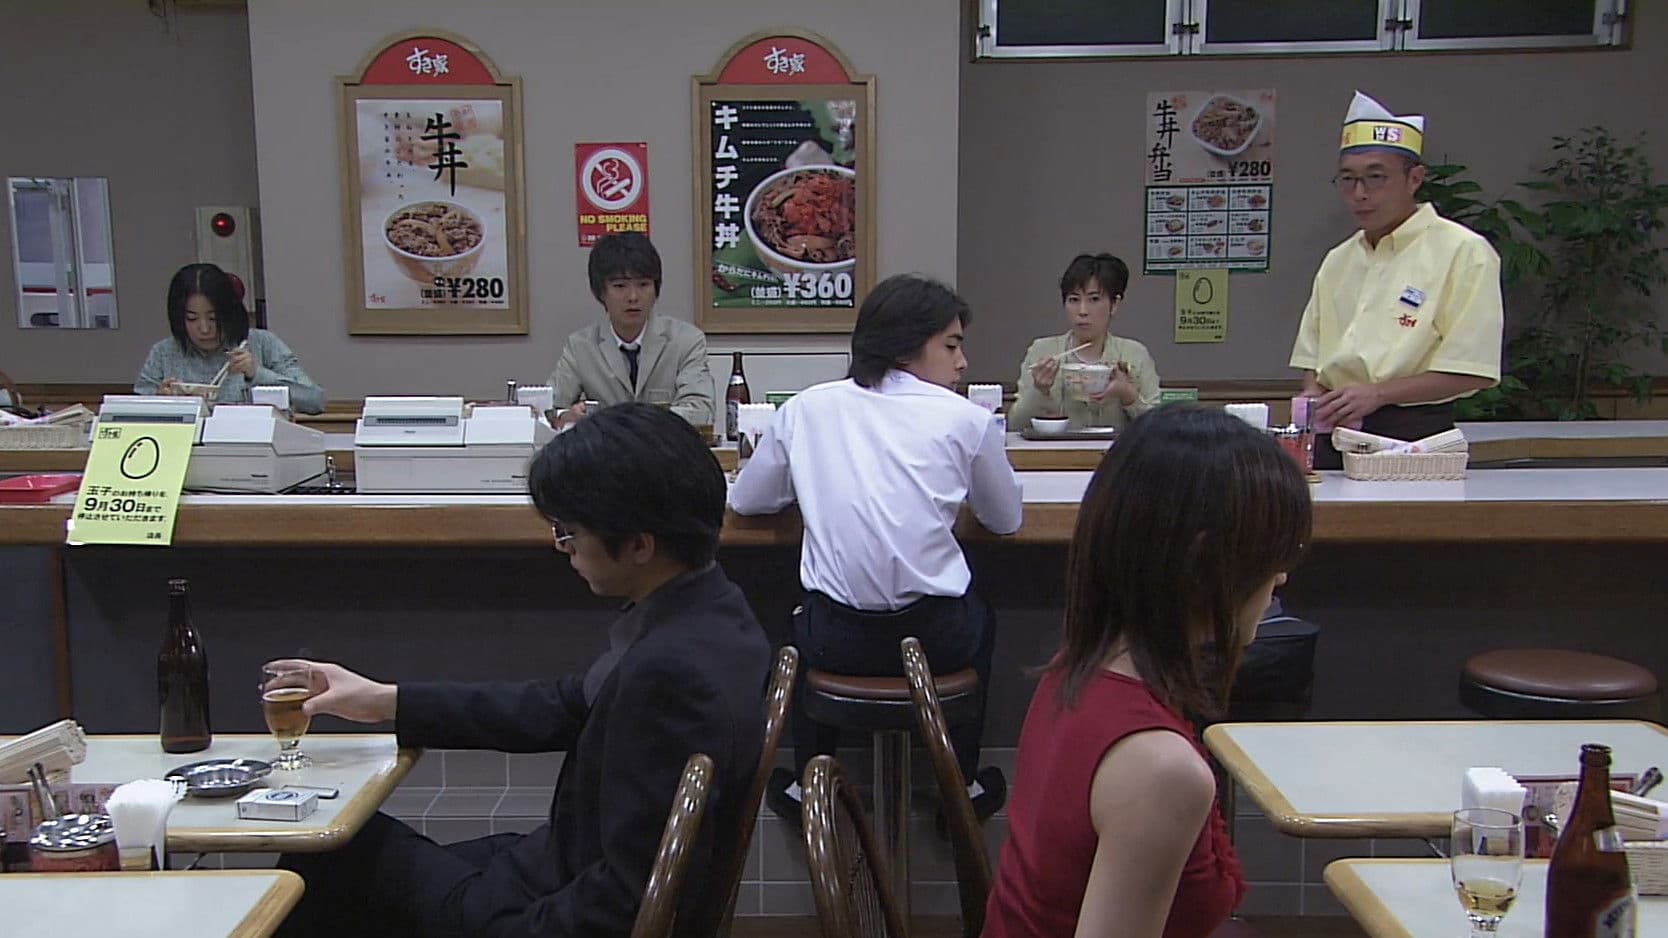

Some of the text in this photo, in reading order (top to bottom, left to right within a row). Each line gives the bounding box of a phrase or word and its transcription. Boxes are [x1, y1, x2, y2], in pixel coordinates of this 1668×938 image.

[406, 47, 449, 77] すき家
[764, 47, 805, 76] すき家
[1148, 99, 1180, 182] 牛丼弁当
[420, 113, 468, 197] 牛丼
[714, 105, 740, 249] キムチ牛丼
[580, 214, 647, 224] NO SMOKING
[606, 223, 647, 232] PLEASE
[447, 278, 504, 299] ¥280
[783, 272, 852, 299] ¥360
[84, 497, 162, 513] 9月30日まで
